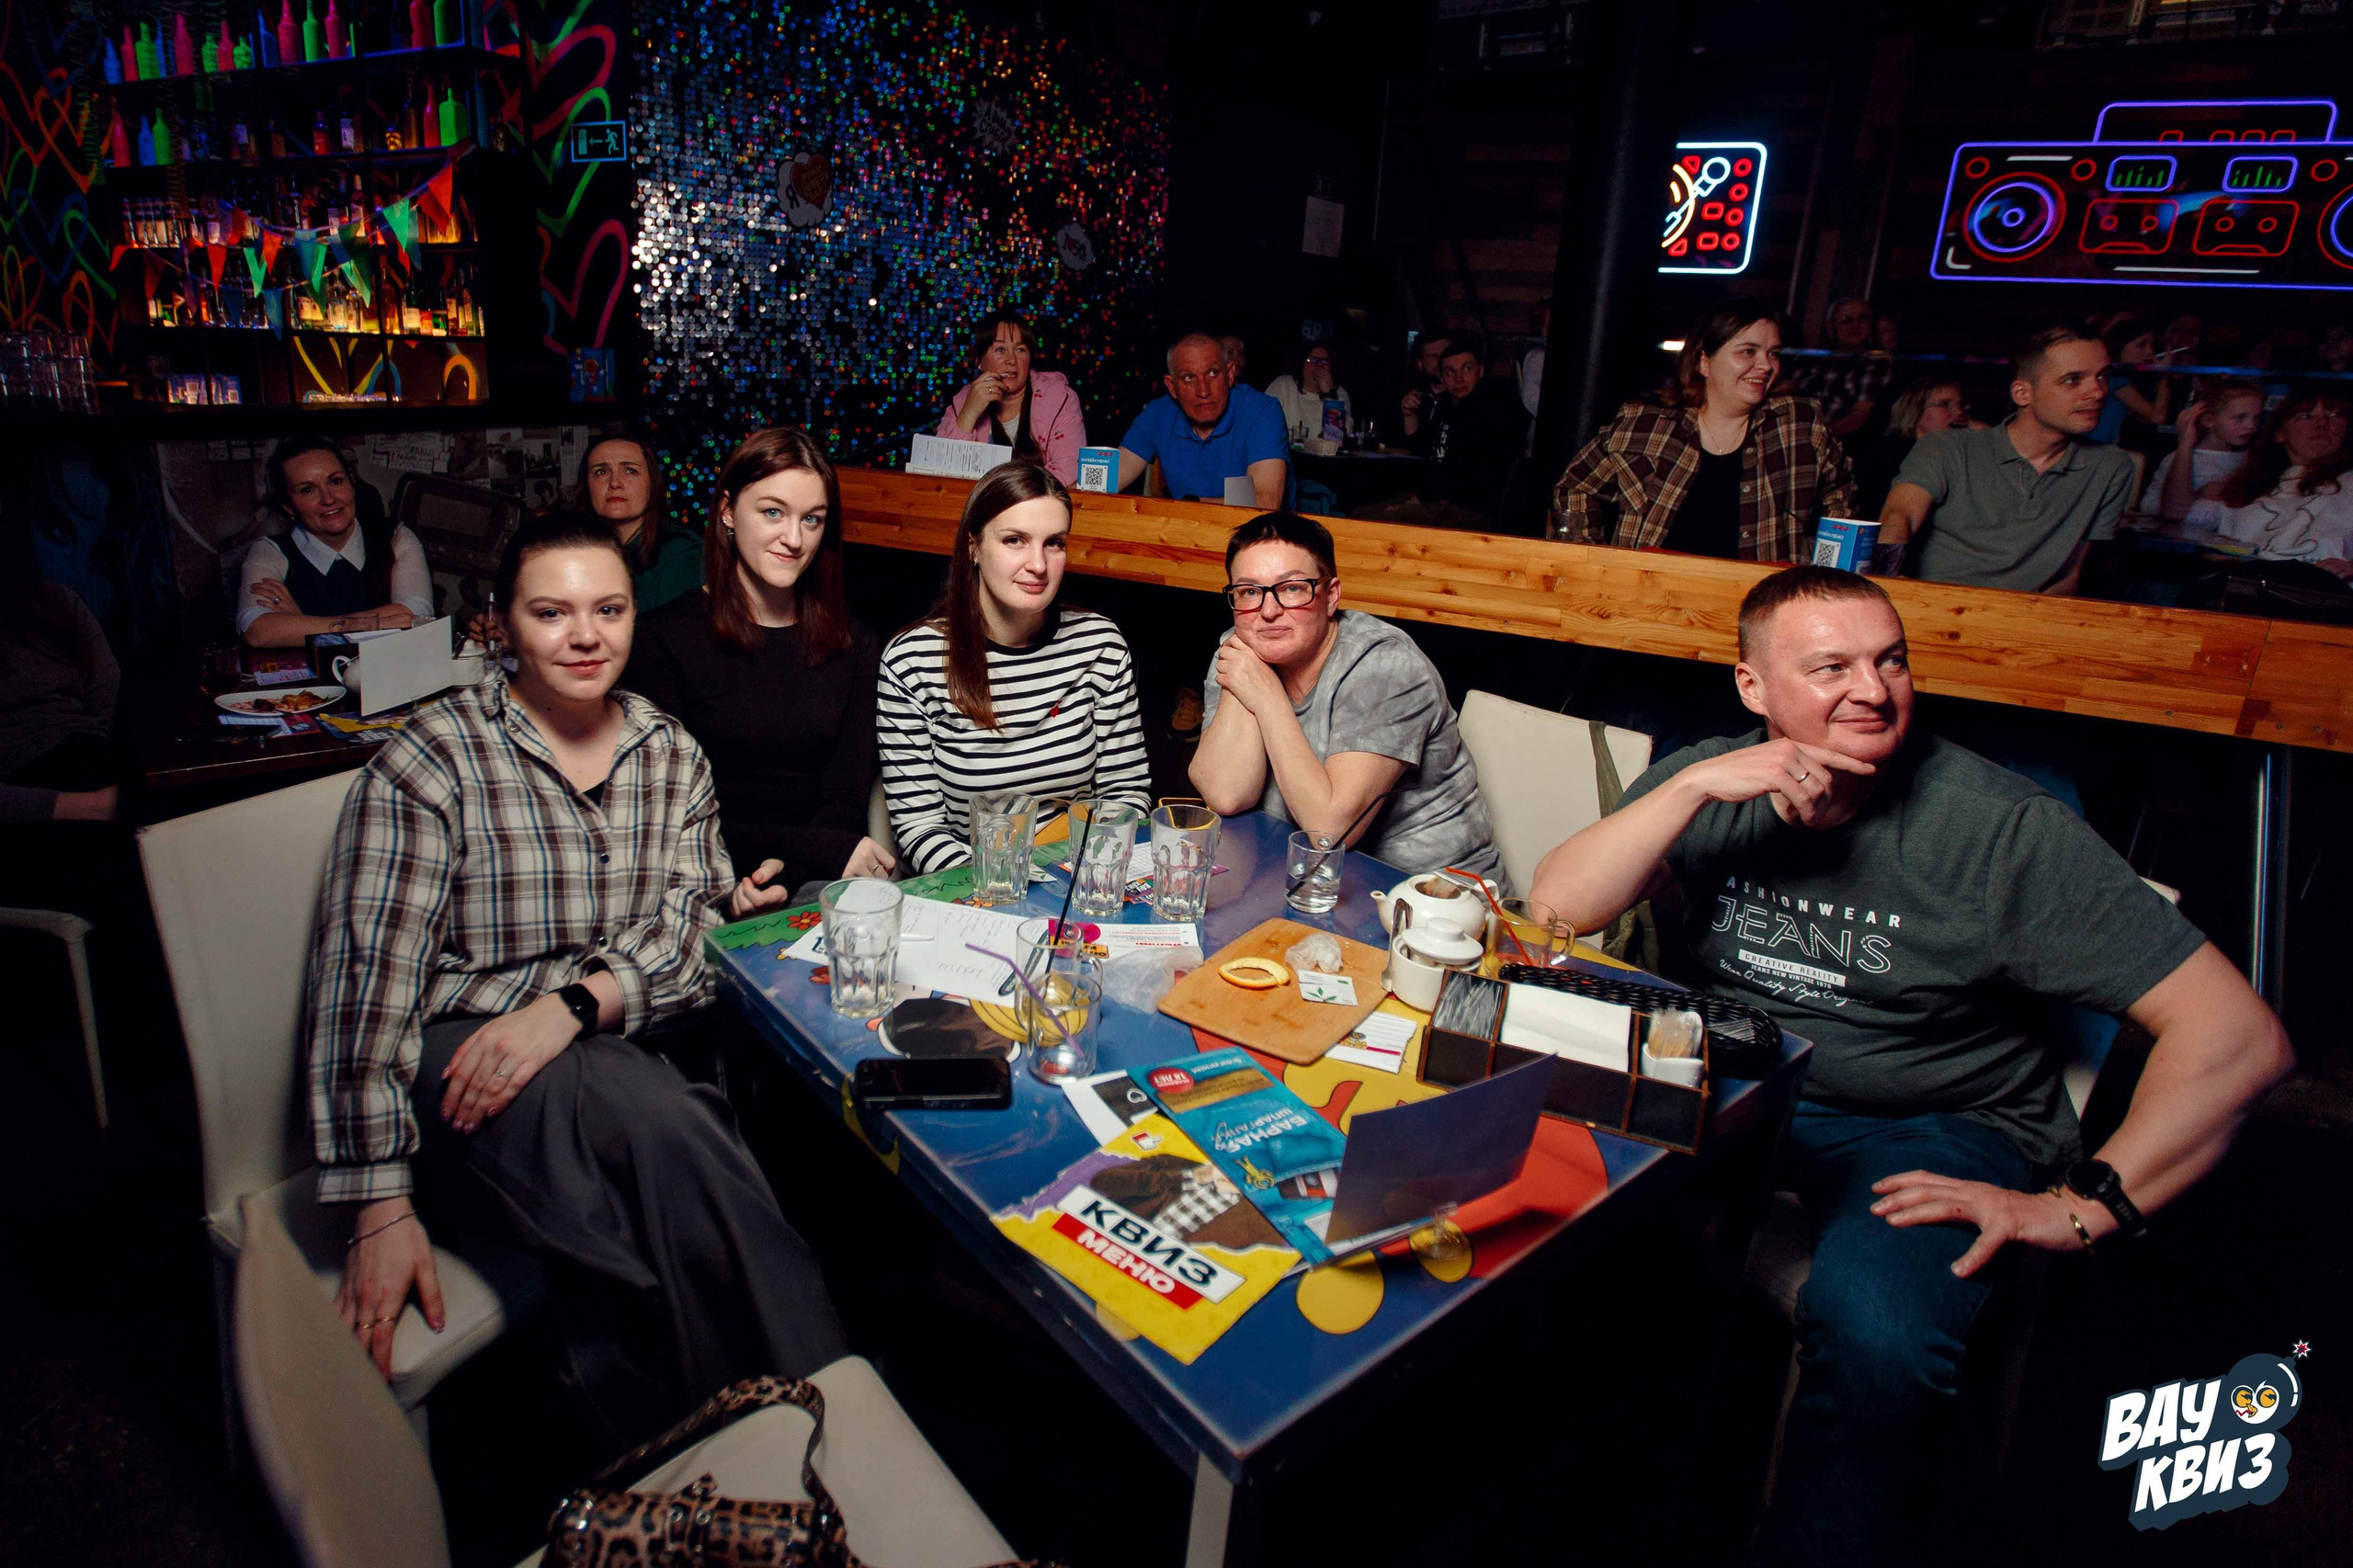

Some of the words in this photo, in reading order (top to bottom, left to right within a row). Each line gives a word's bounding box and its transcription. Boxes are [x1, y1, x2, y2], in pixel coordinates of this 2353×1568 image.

[1711, 895, 1892, 973] JEANS
[1744, 970, 1787, 995] Quality
[1789, 983, 1821, 1003] Style
[1745, 953, 1794, 971] CREATIVE
[1800, 965, 1838, 983] REALITY
[1751, 964, 1771, 975] JEANS
[1771, 970, 1787, 979] NEW
[1789, 972, 1814, 985] VINTAGE
[1223, 1114, 1308, 1153] БАРНАЯ
[1077, 1229, 1176, 1293] МЕНЮ
[1079, 1199, 1219, 1288] КВИЗ
